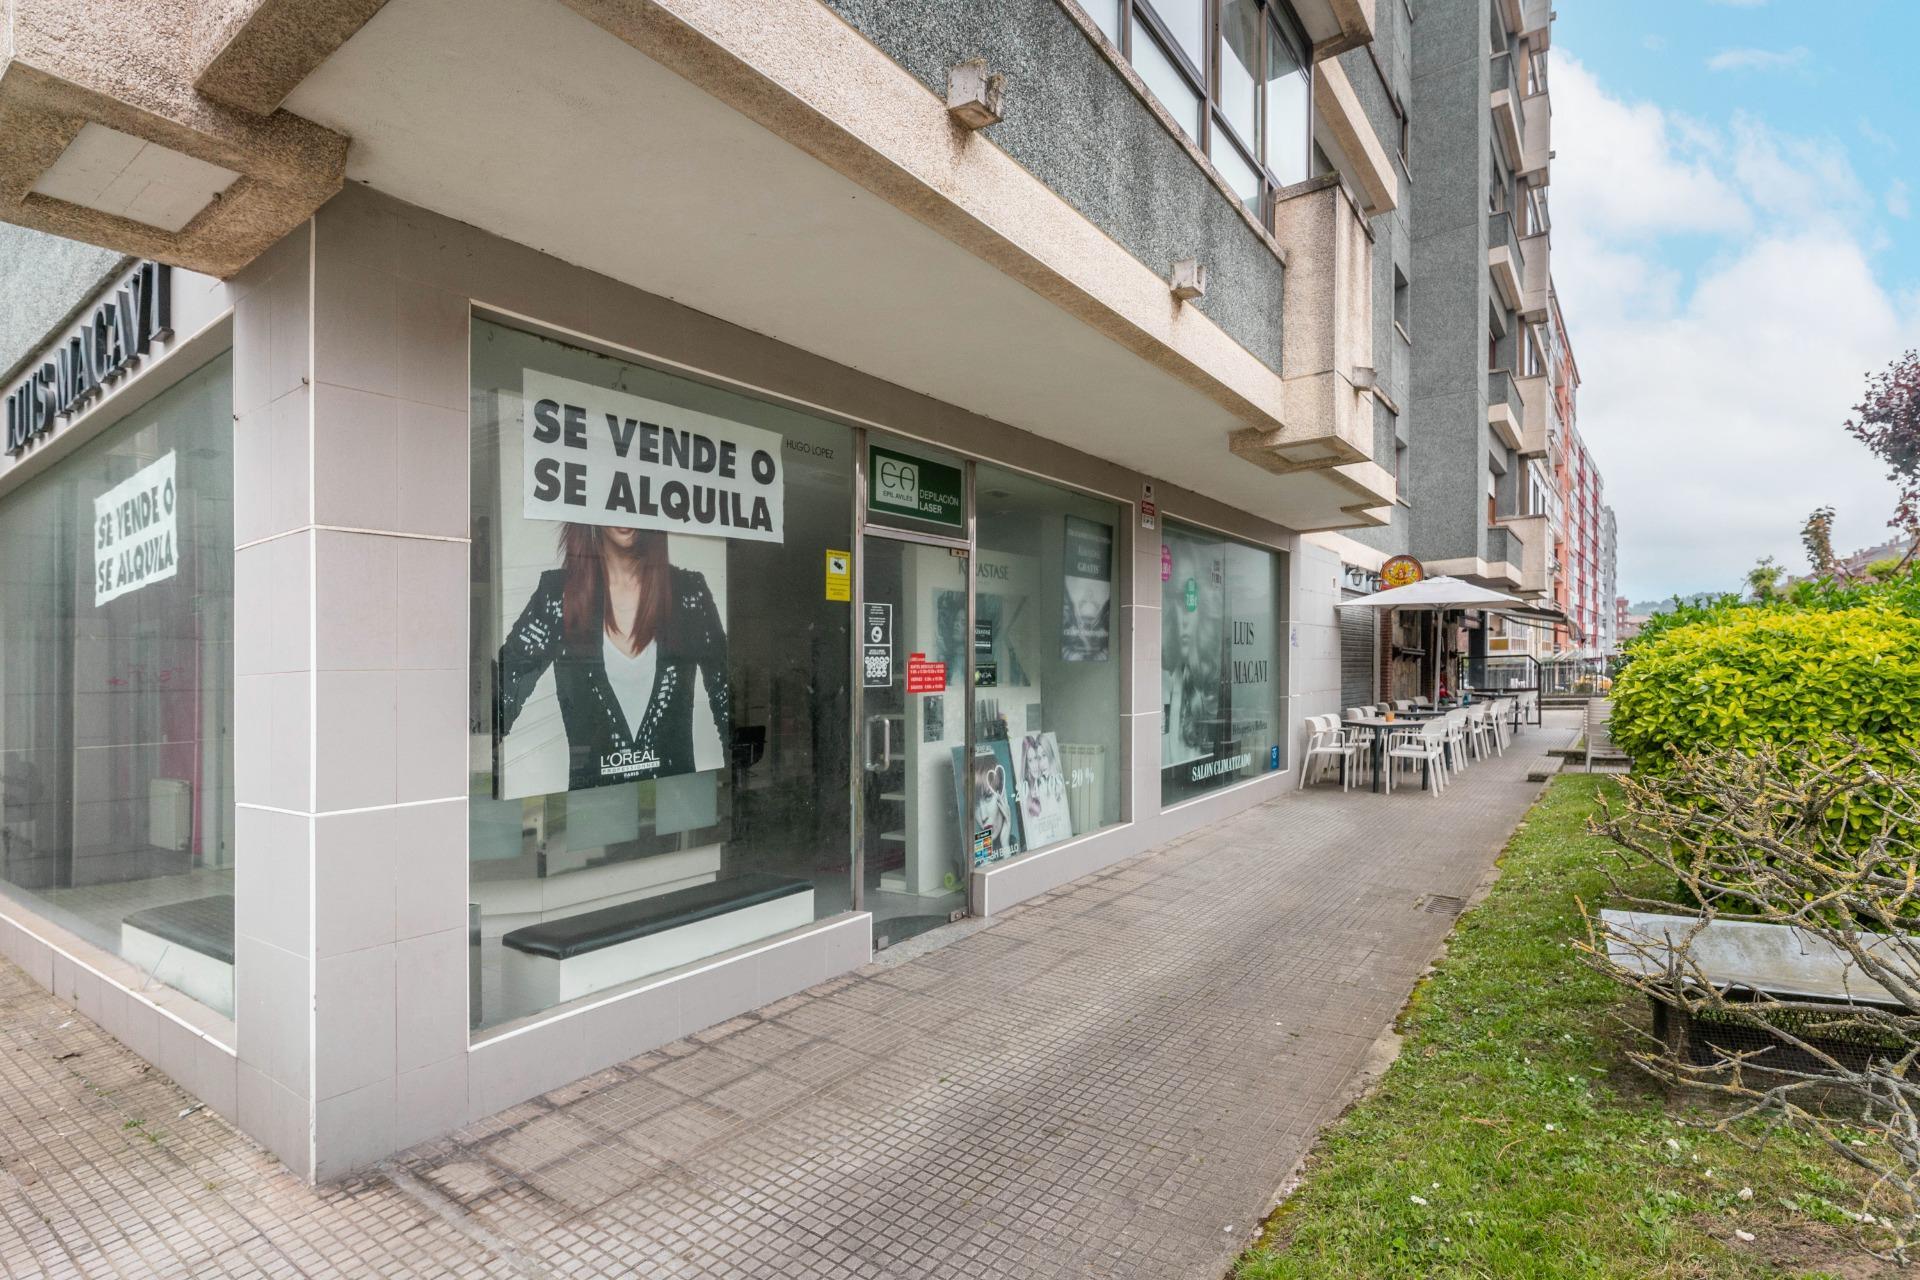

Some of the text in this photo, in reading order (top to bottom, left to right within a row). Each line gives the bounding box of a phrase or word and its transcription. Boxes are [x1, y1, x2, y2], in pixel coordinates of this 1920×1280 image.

[6, 262, 174, 456] LUIS MACAVI
[532, 398, 776, 486] SE VENDE O
[786, 439, 834, 459] HUGO LOPEZ
[533, 457, 773, 533] SE ALQUILA
[919, 501, 943, 515] LASER
[98, 477, 174, 549] SE VENDE O
[98, 529, 174, 594] SE ALQUILA
[1233, 621, 1255, 646] LUIS
[1233, 660, 1268, 684] MACAVI
[602, 761, 660, 775] PROFESSIONNEL
[1071, 768, 1084, 788] 20
[1191, 752, 1252, 782] SALON CLIMATIZADO
